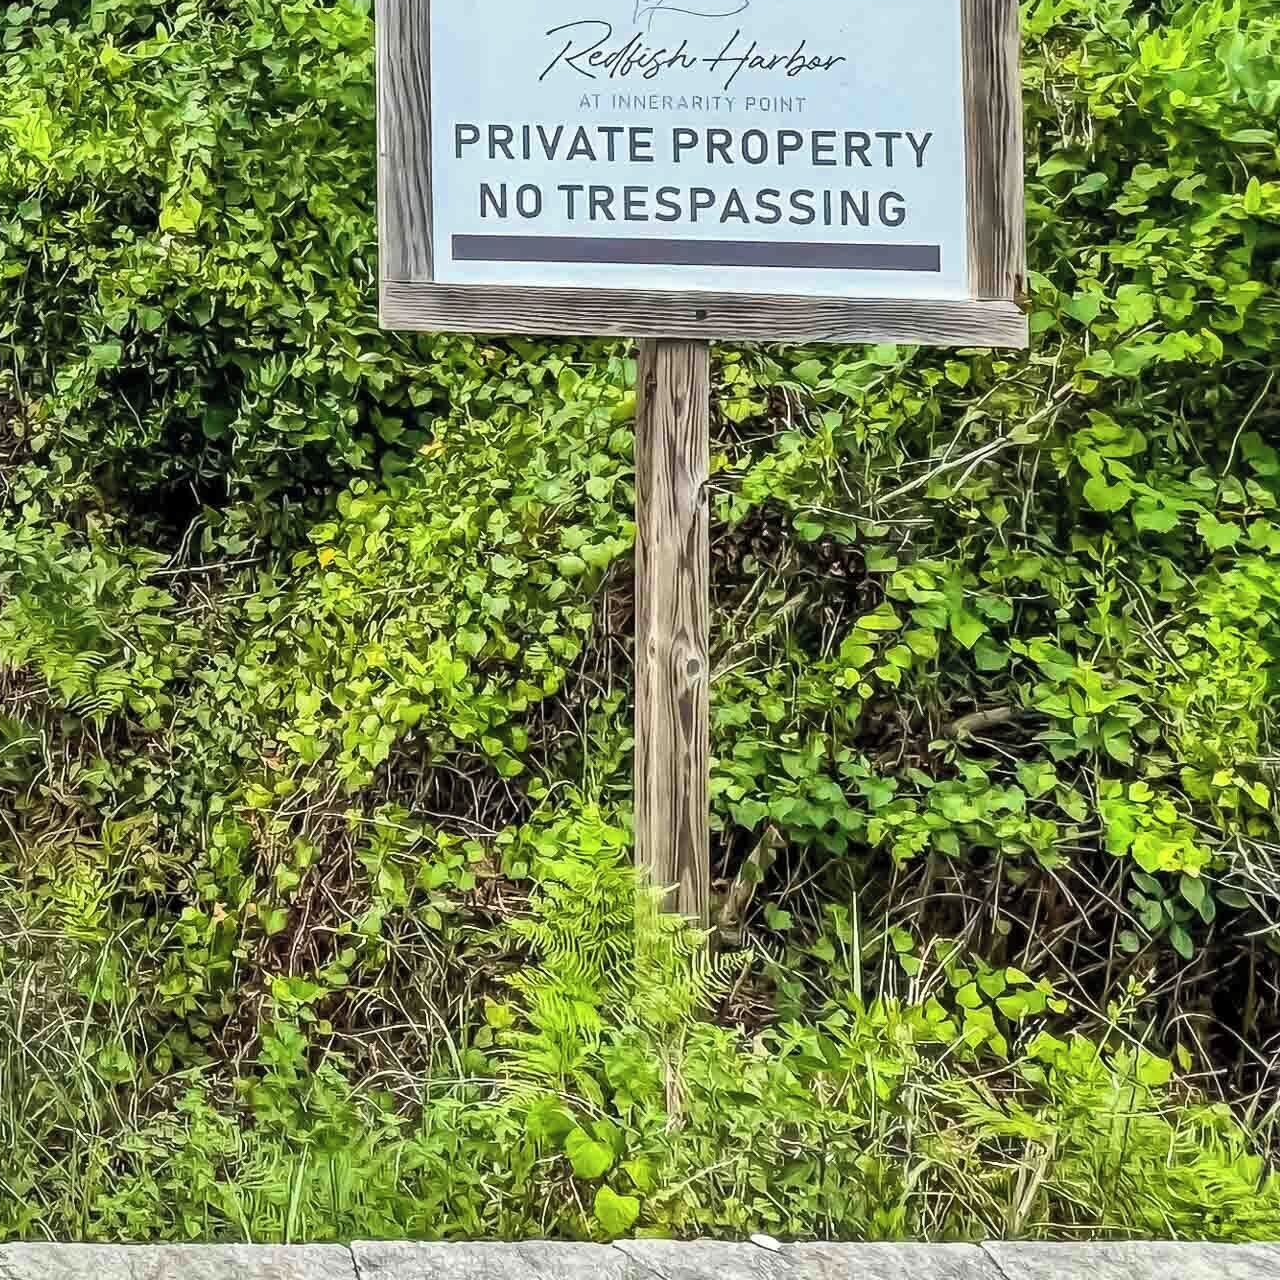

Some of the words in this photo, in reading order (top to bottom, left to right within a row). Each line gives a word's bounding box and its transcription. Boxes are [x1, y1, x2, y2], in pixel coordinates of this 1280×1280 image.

[539, 20, 697, 81] Redfish
[702, 29, 847, 91] Harbor
[579, 94, 602, 110] AT
[611, 94, 736, 113] INNERARITY
[745, 96, 807, 113] POINT
[455, 123, 654, 163] PRIVATE
[672, 127, 933, 168] PROPERTY
[479, 184, 542, 219] NO
[557, 185, 907, 227] TRESPASSING
